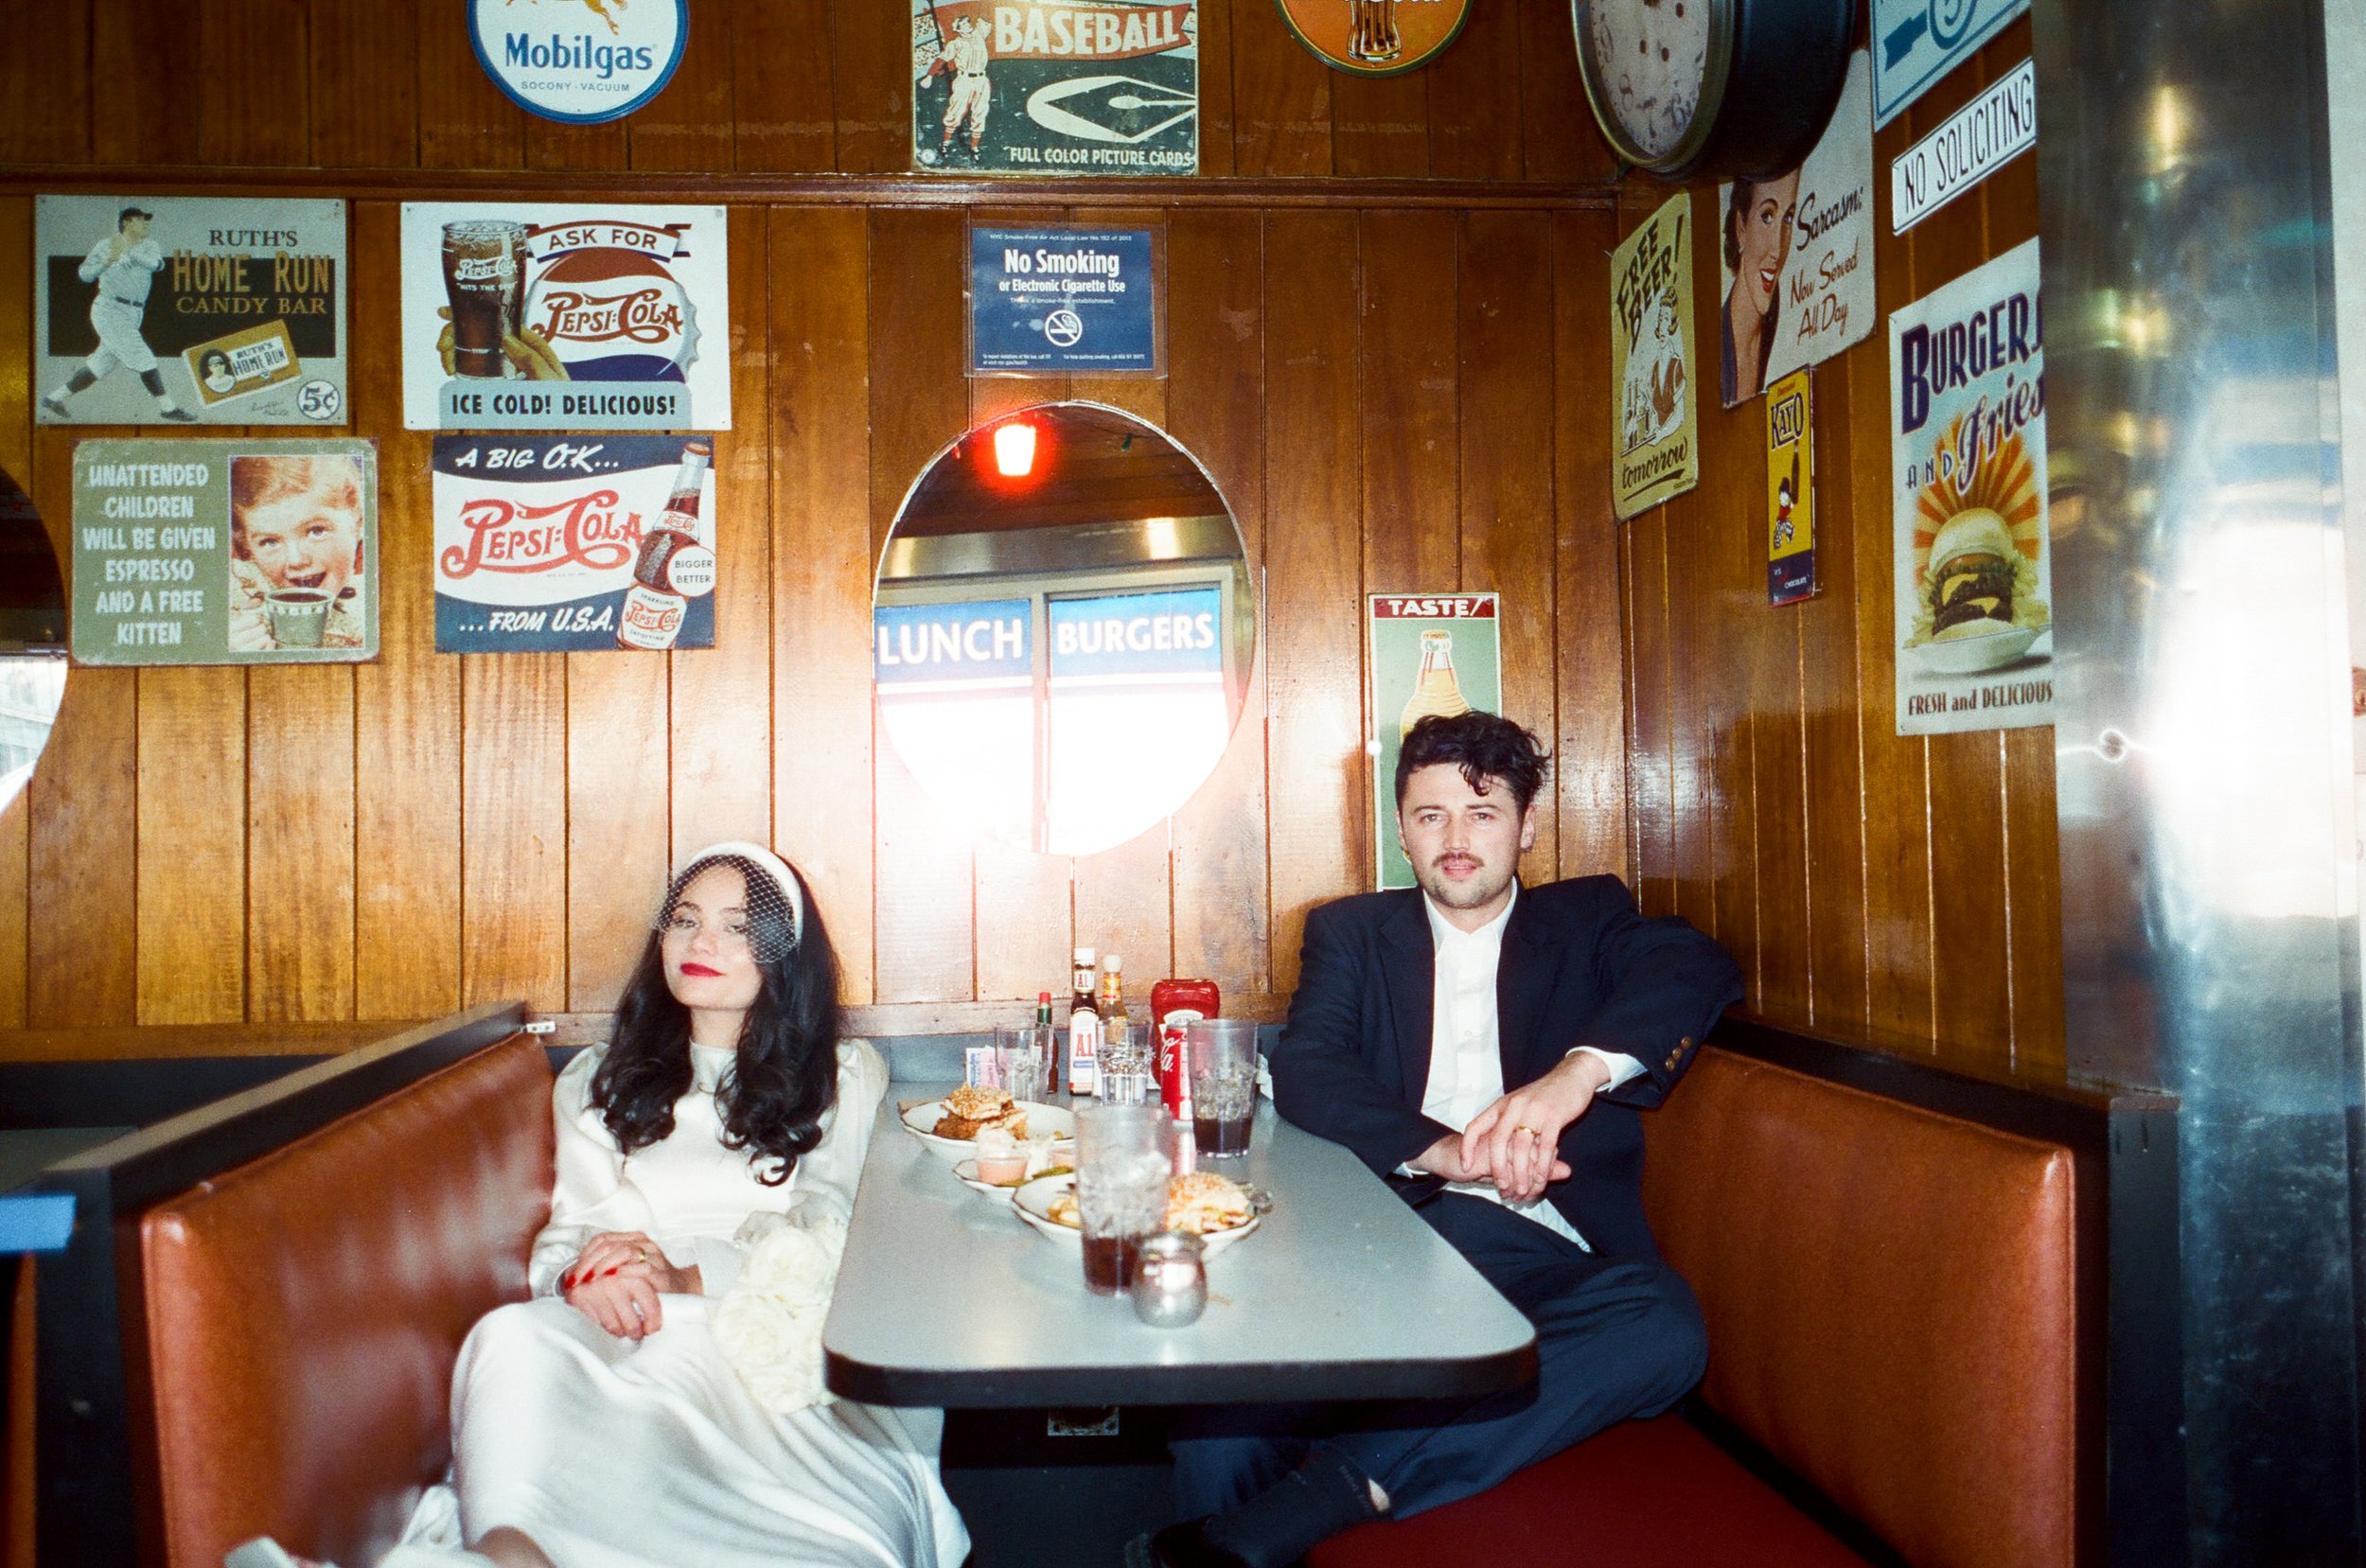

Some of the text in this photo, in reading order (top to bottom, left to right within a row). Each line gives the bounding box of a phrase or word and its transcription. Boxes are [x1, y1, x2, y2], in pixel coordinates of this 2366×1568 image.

[995, 7, 1179, 54] BASEBALL
[505, 32, 653, 79] Mobilgas
[1905, 73, 2032, 214] NO SOLICITING
[1010, 148, 1192, 167] FULL COLOR PICTURE CARDS
[1796, 185, 1863, 252] Sarcasm:
[209, 229, 298, 247] RUTH'S
[549, 228, 658, 251] ASK FOR
[173, 248, 330, 293] HOME RUN
[1004, 248, 1121, 277] No Smoking
[1791, 236, 1860, 308] Now Served
[998, 278, 1126, 294] or Electronic Cigarette Use
[1616, 218, 1659, 334] FREE
[175, 296, 327, 314] CANDY BAR
[1797, 292, 1848, 345] All Day
[232, 357, 264, 376] HOME
[452, 394, 676, 416] ICE COLD! DELICIOUS!
[1771, 392, 1804, 449] KAYO
[455, 448, 479, 467] A
[486, 448, 535, 469] BIG
[1622, 435, 1688, 489] tomorrow
[1906, 451, 1953, 489] AND
[89, 464, 208, 487] UNATTENDED
[105, 495, 194, 519] CHILDREN
[82, 526, 216, 551] WILL BE GIVEN
[105, 558, 195, 583] ESPRESSO
[675, 559, 713, 569] BIGGER
[676, 574, 712, 584] BETTER
[96, 590, 204, 615] AND A FREE
[552, 605, 614, 632] U.S.A.
[116, 622, 182, 645] KITTEN
[876, 618, 1023, 666] LUNCH
[1055, 611, 1215, 656] BURGERS
[1908, 679, 2054, 716] FRESH and DELICIOUS
